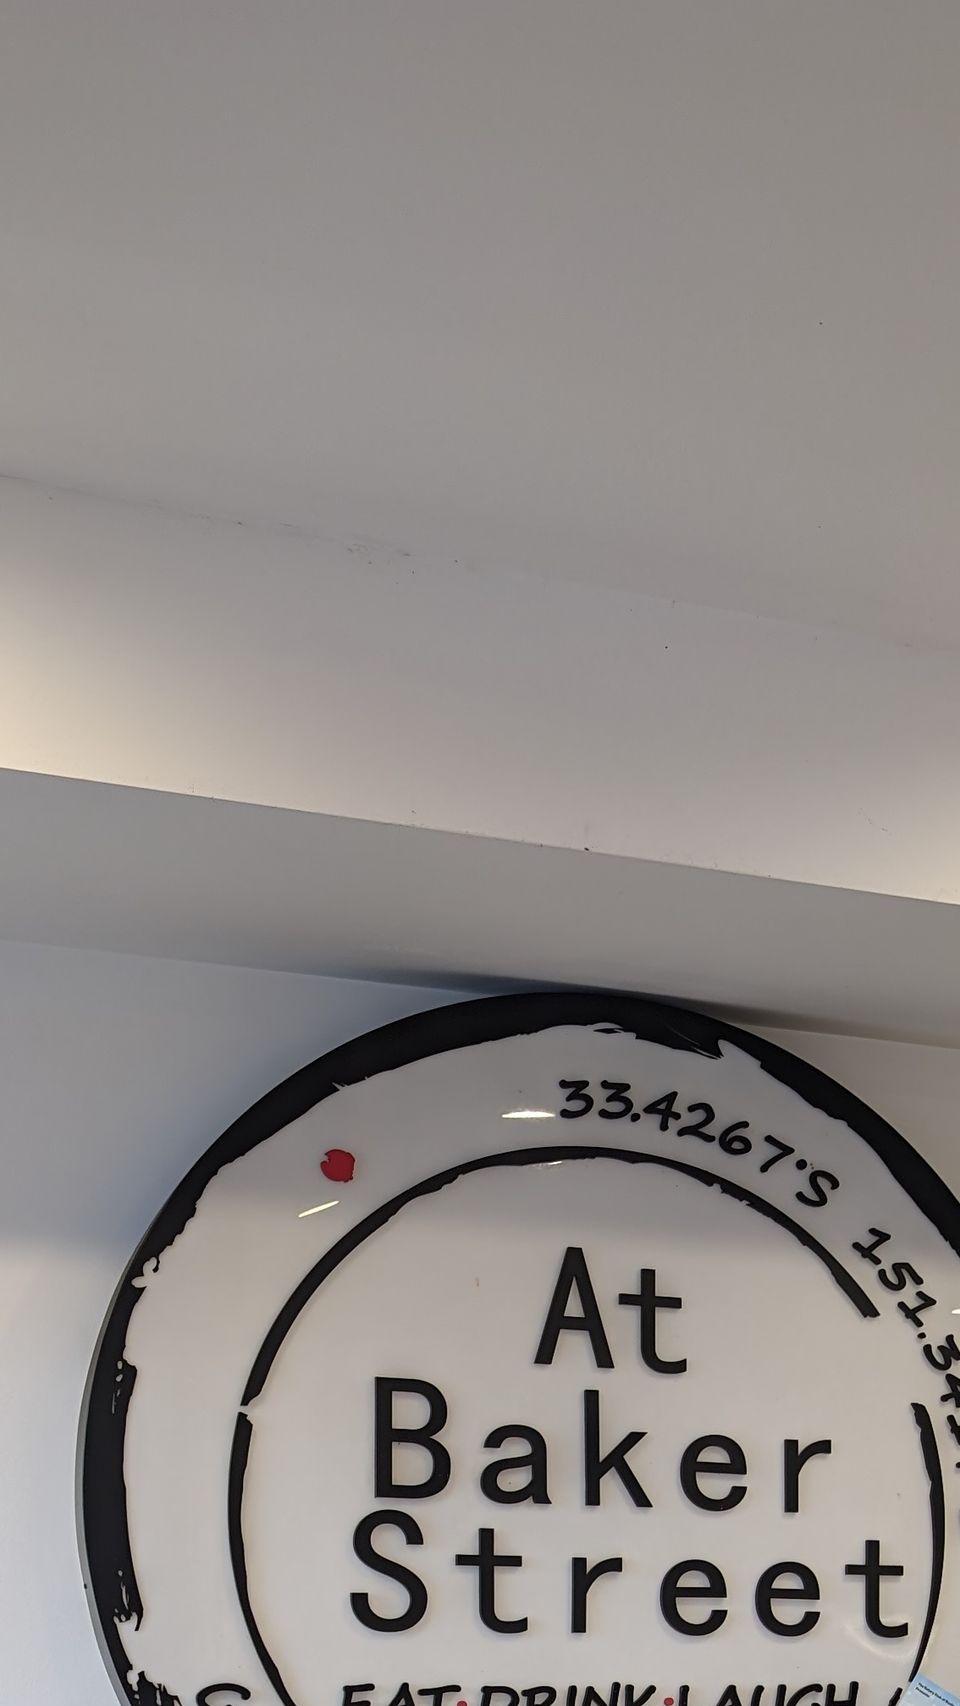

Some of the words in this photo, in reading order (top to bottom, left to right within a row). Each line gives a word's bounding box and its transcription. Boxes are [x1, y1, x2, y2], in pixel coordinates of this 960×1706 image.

[534, 1247, 688, 1375] At
[375, 1377, 832, 1513] Baker
[350, 1510, 909, 1639] Street
